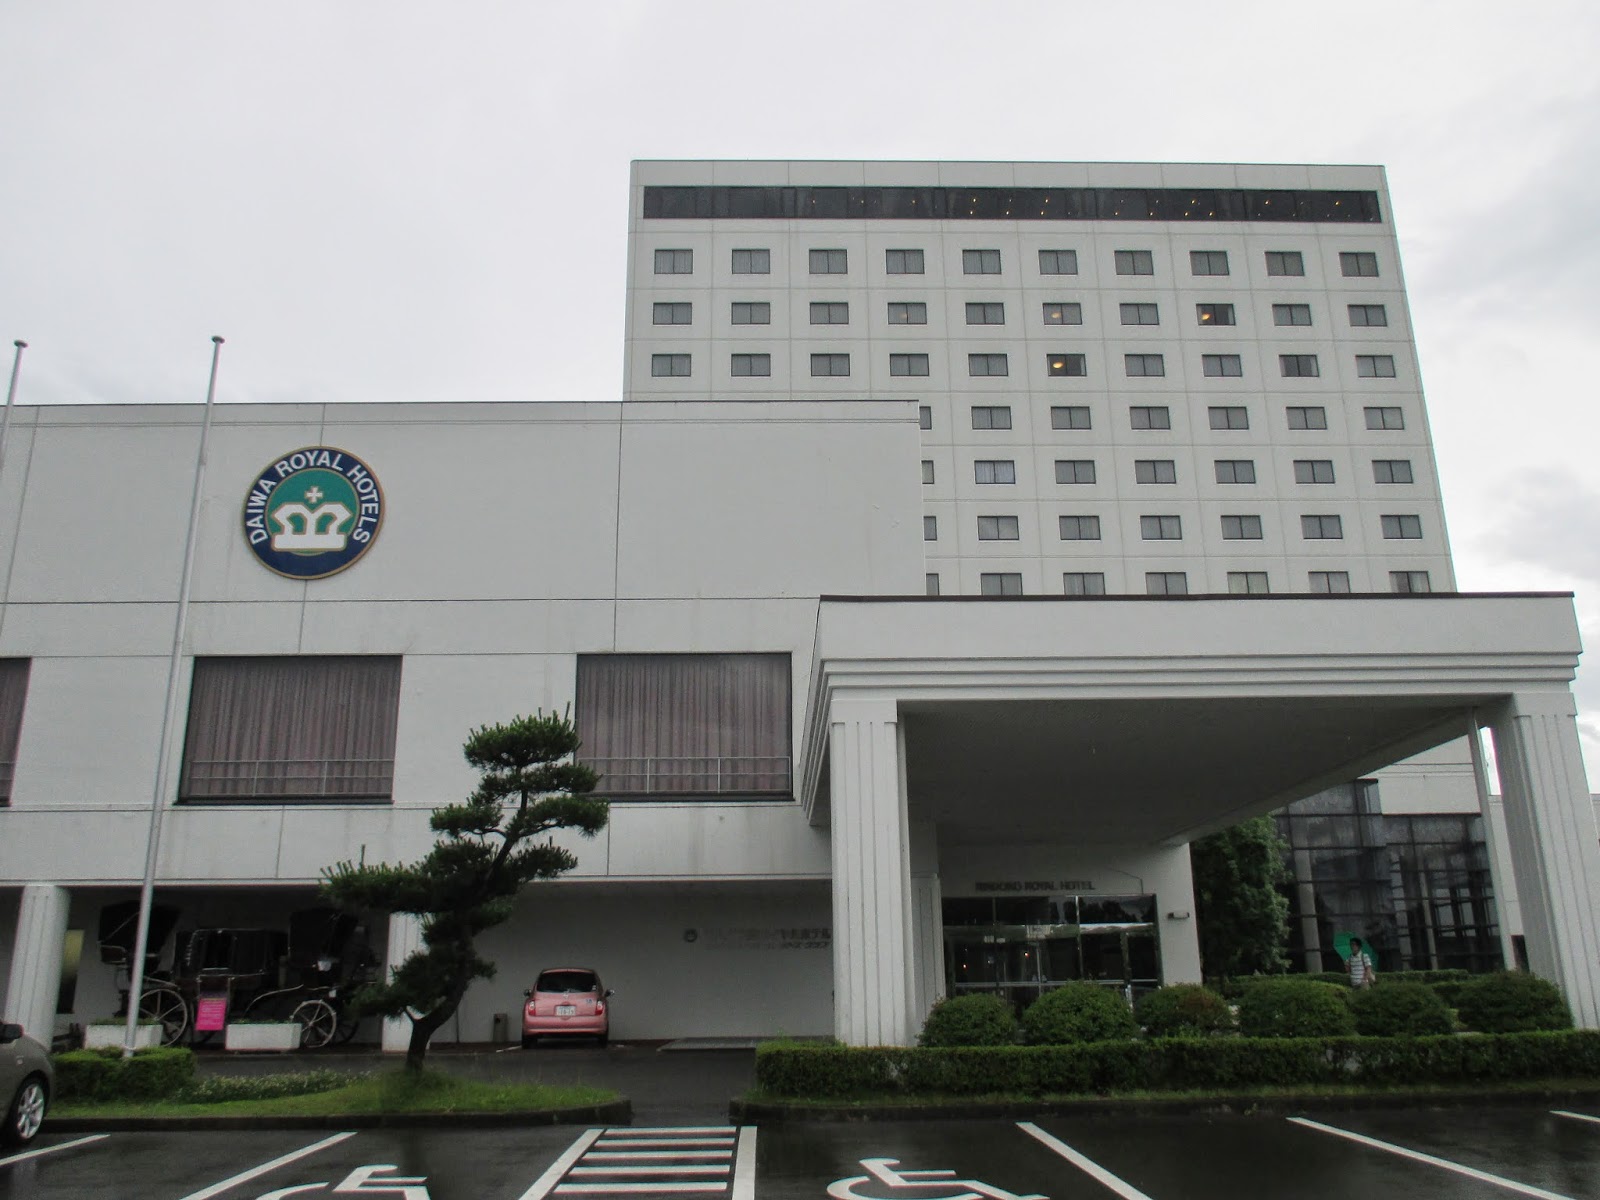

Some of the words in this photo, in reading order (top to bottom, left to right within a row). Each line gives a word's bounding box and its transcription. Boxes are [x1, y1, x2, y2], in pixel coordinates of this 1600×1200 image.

[246, 478, 277, 545] DAIWA
[274, 450, 344, 478] ROYAL
[346, 464, 379, 544] HOTELS
[1060, 880, 1096, 890] HOTEL
